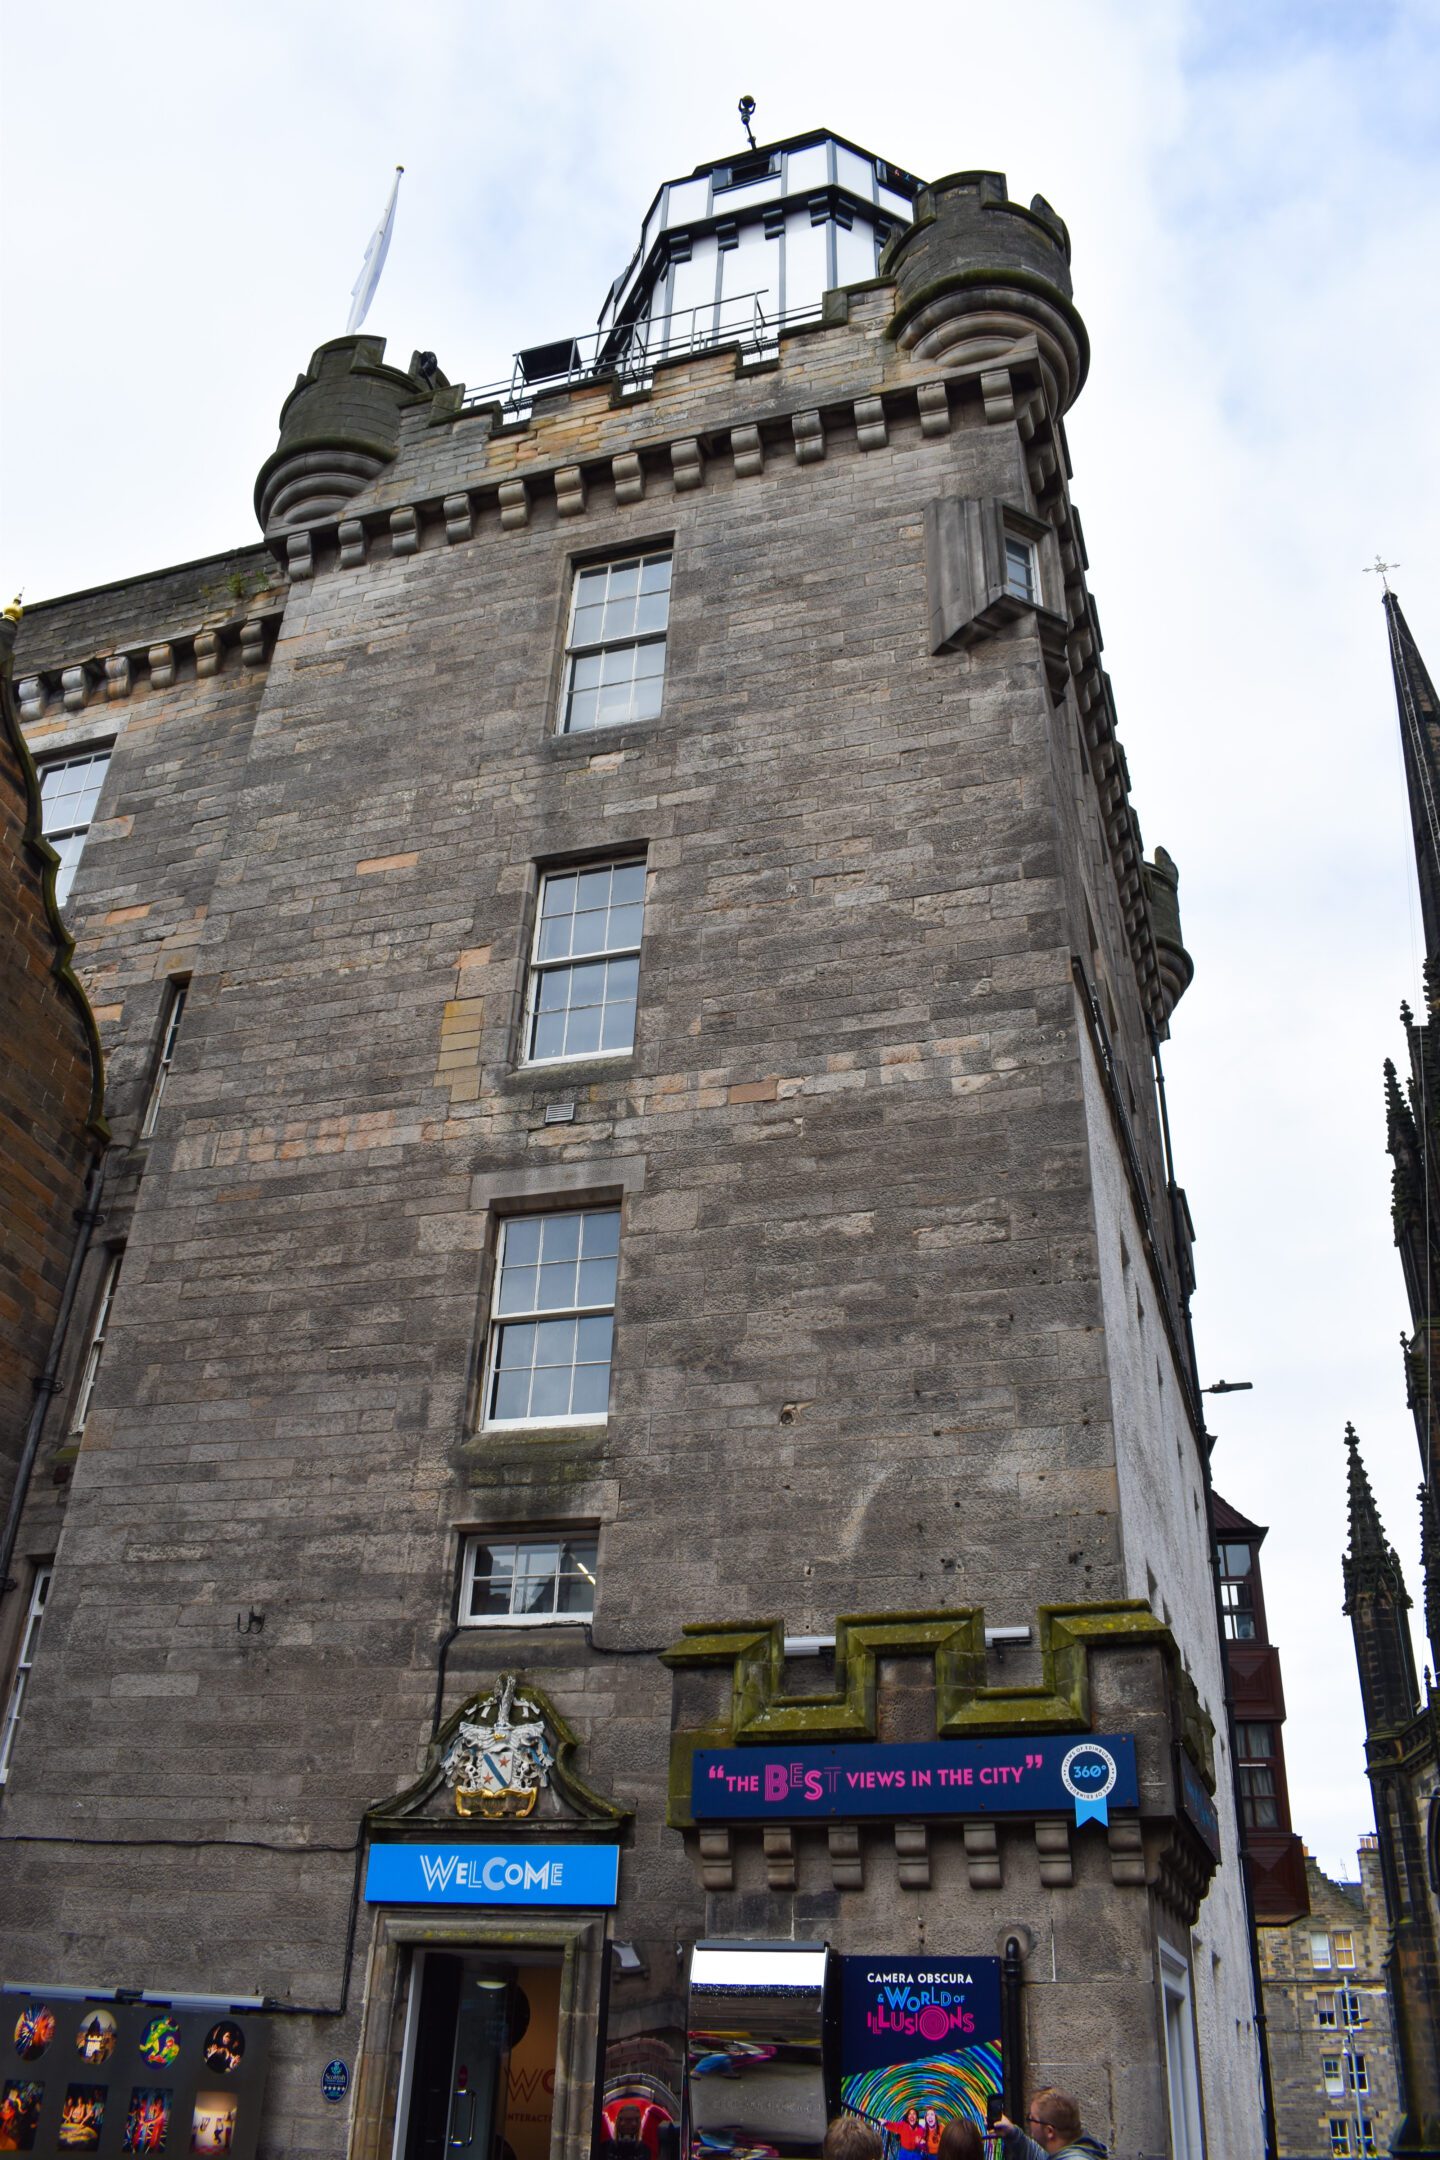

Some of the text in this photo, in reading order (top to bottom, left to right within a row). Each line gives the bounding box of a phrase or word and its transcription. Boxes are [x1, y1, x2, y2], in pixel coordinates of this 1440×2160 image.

[846, 1771, 906, 1789] VIEWS
[911, 1770, 932, 1787] IN
[937, 1768, 974, 1786] THE
[867, 1973, 974, 1984] CAMERA OBSCURA
[877, 1992, 885, 2004] &
[953, 1995, 966, 2004] OF
